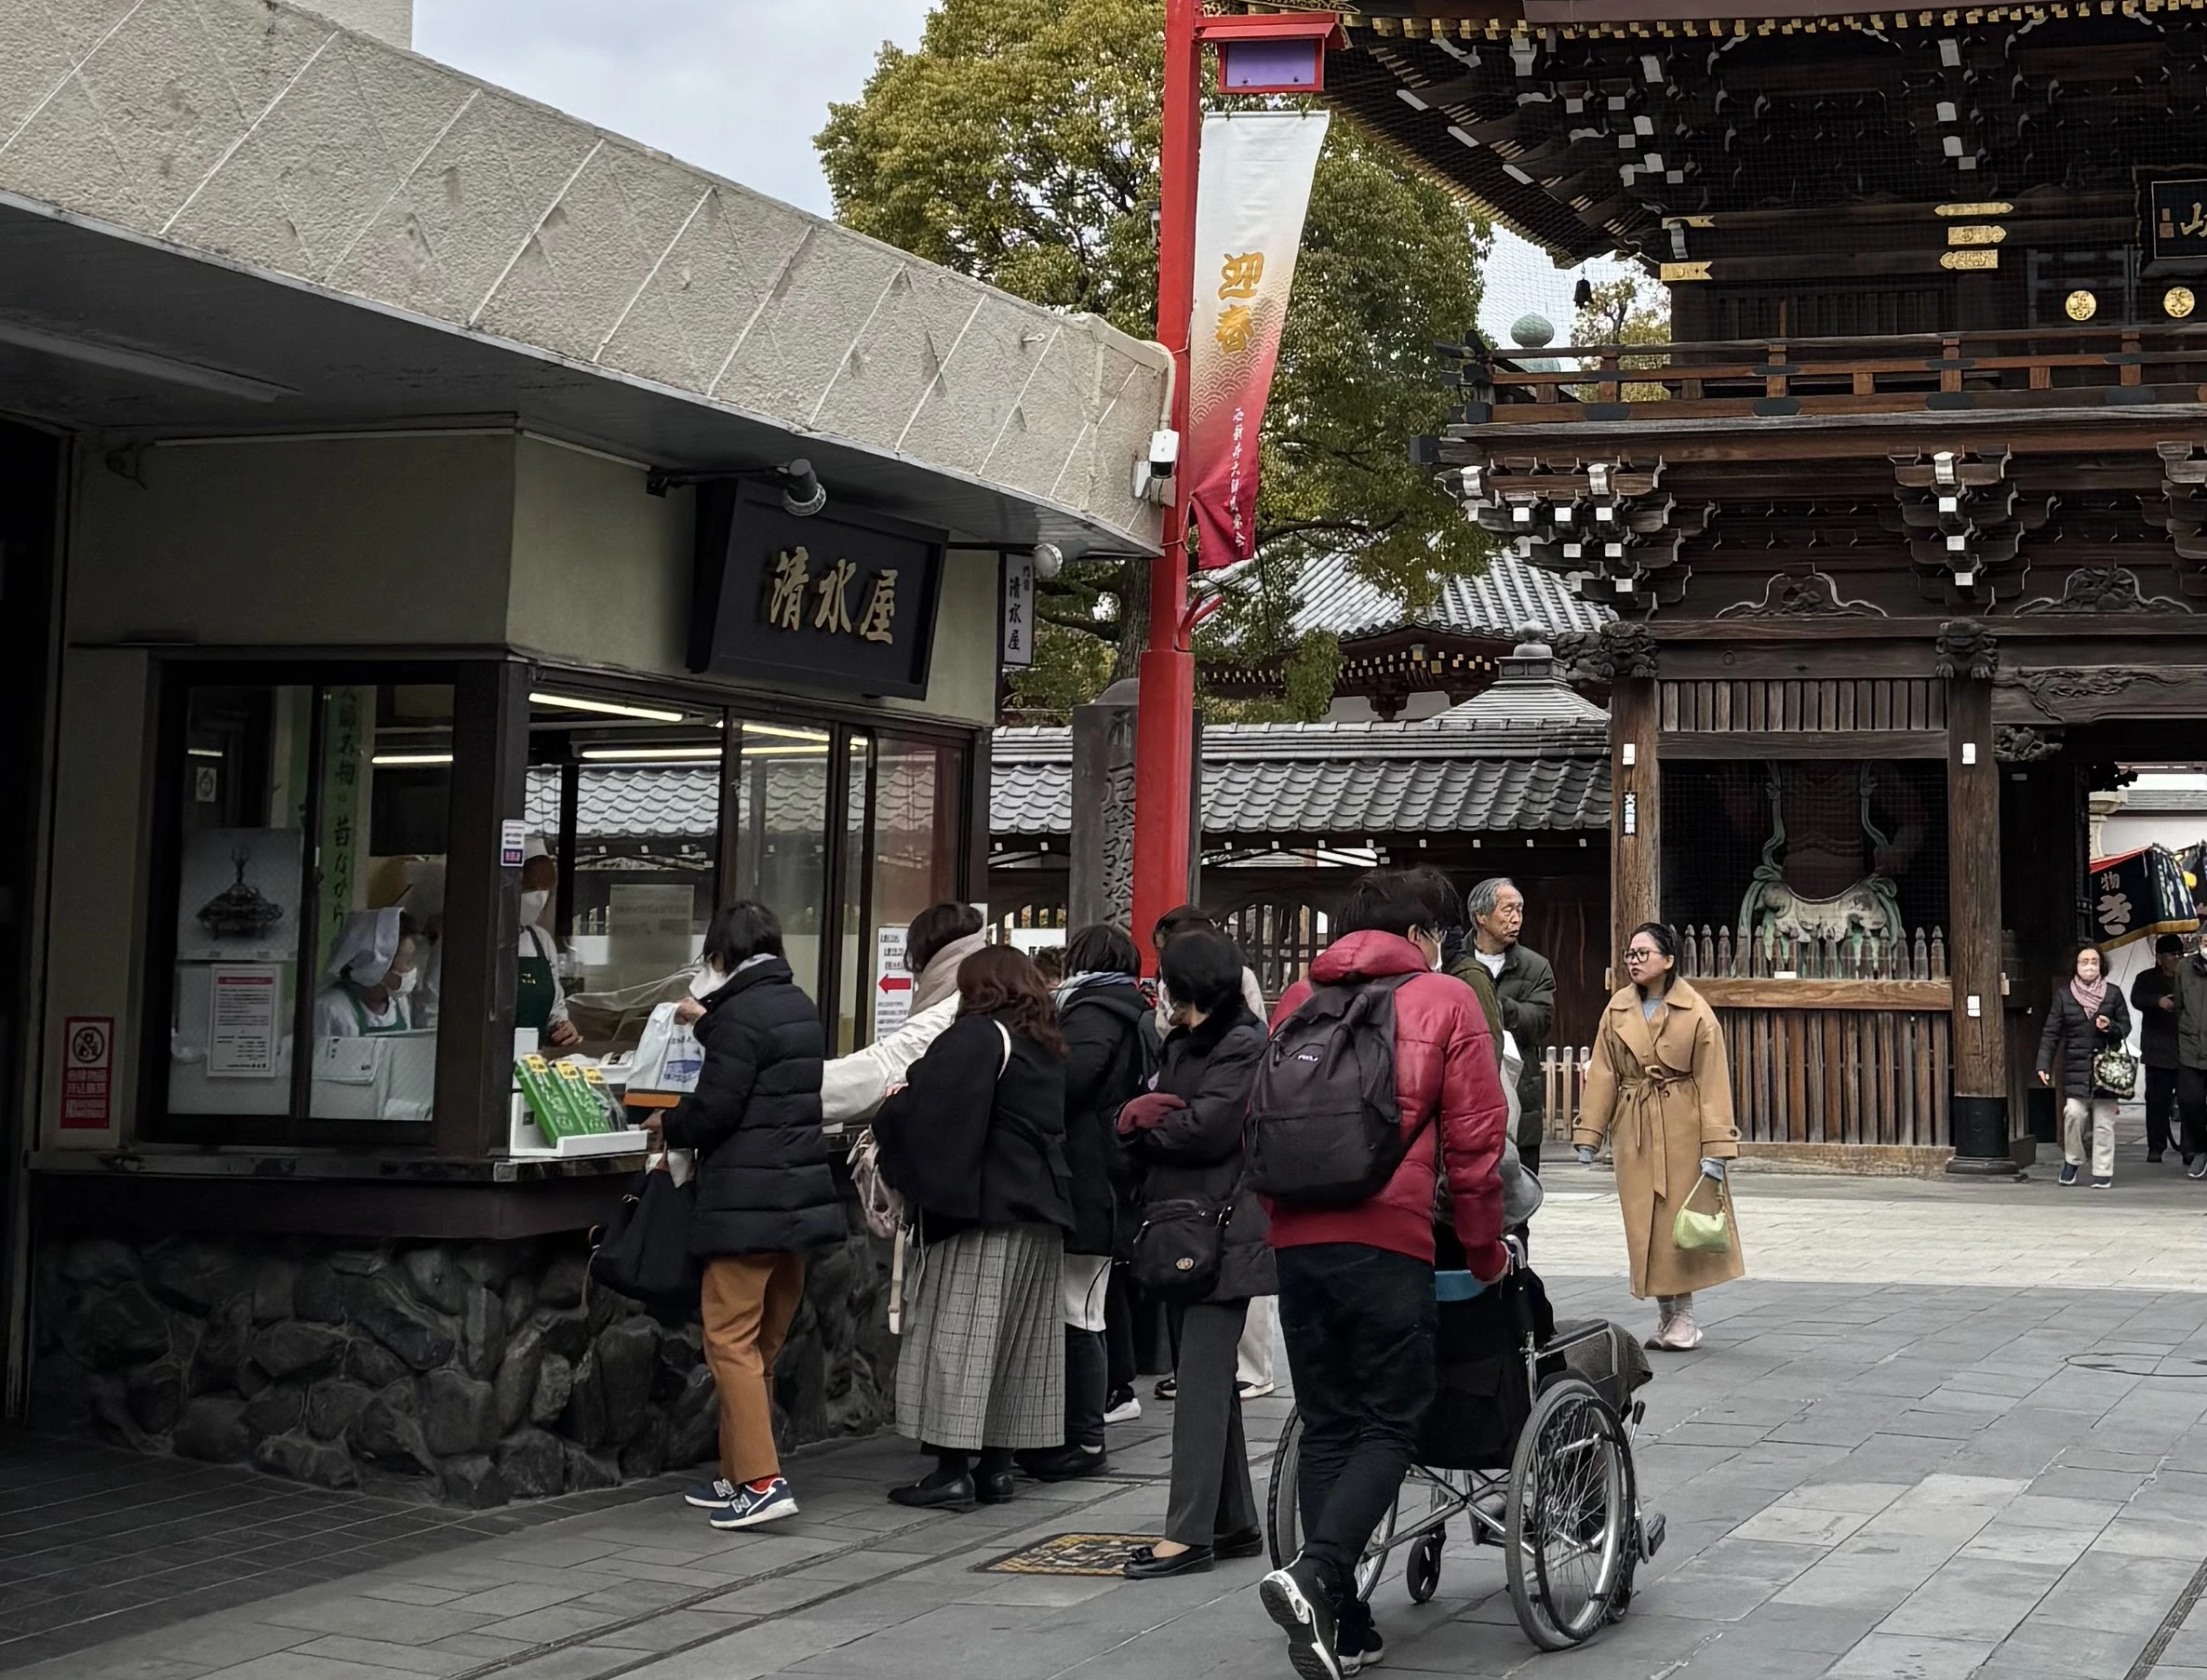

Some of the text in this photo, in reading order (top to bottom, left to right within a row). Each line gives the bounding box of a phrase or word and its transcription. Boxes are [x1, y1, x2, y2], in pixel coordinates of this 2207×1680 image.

[769, 545, 898, 646] 清水屋
[1008, 576, 1022, 651] 清水屋
